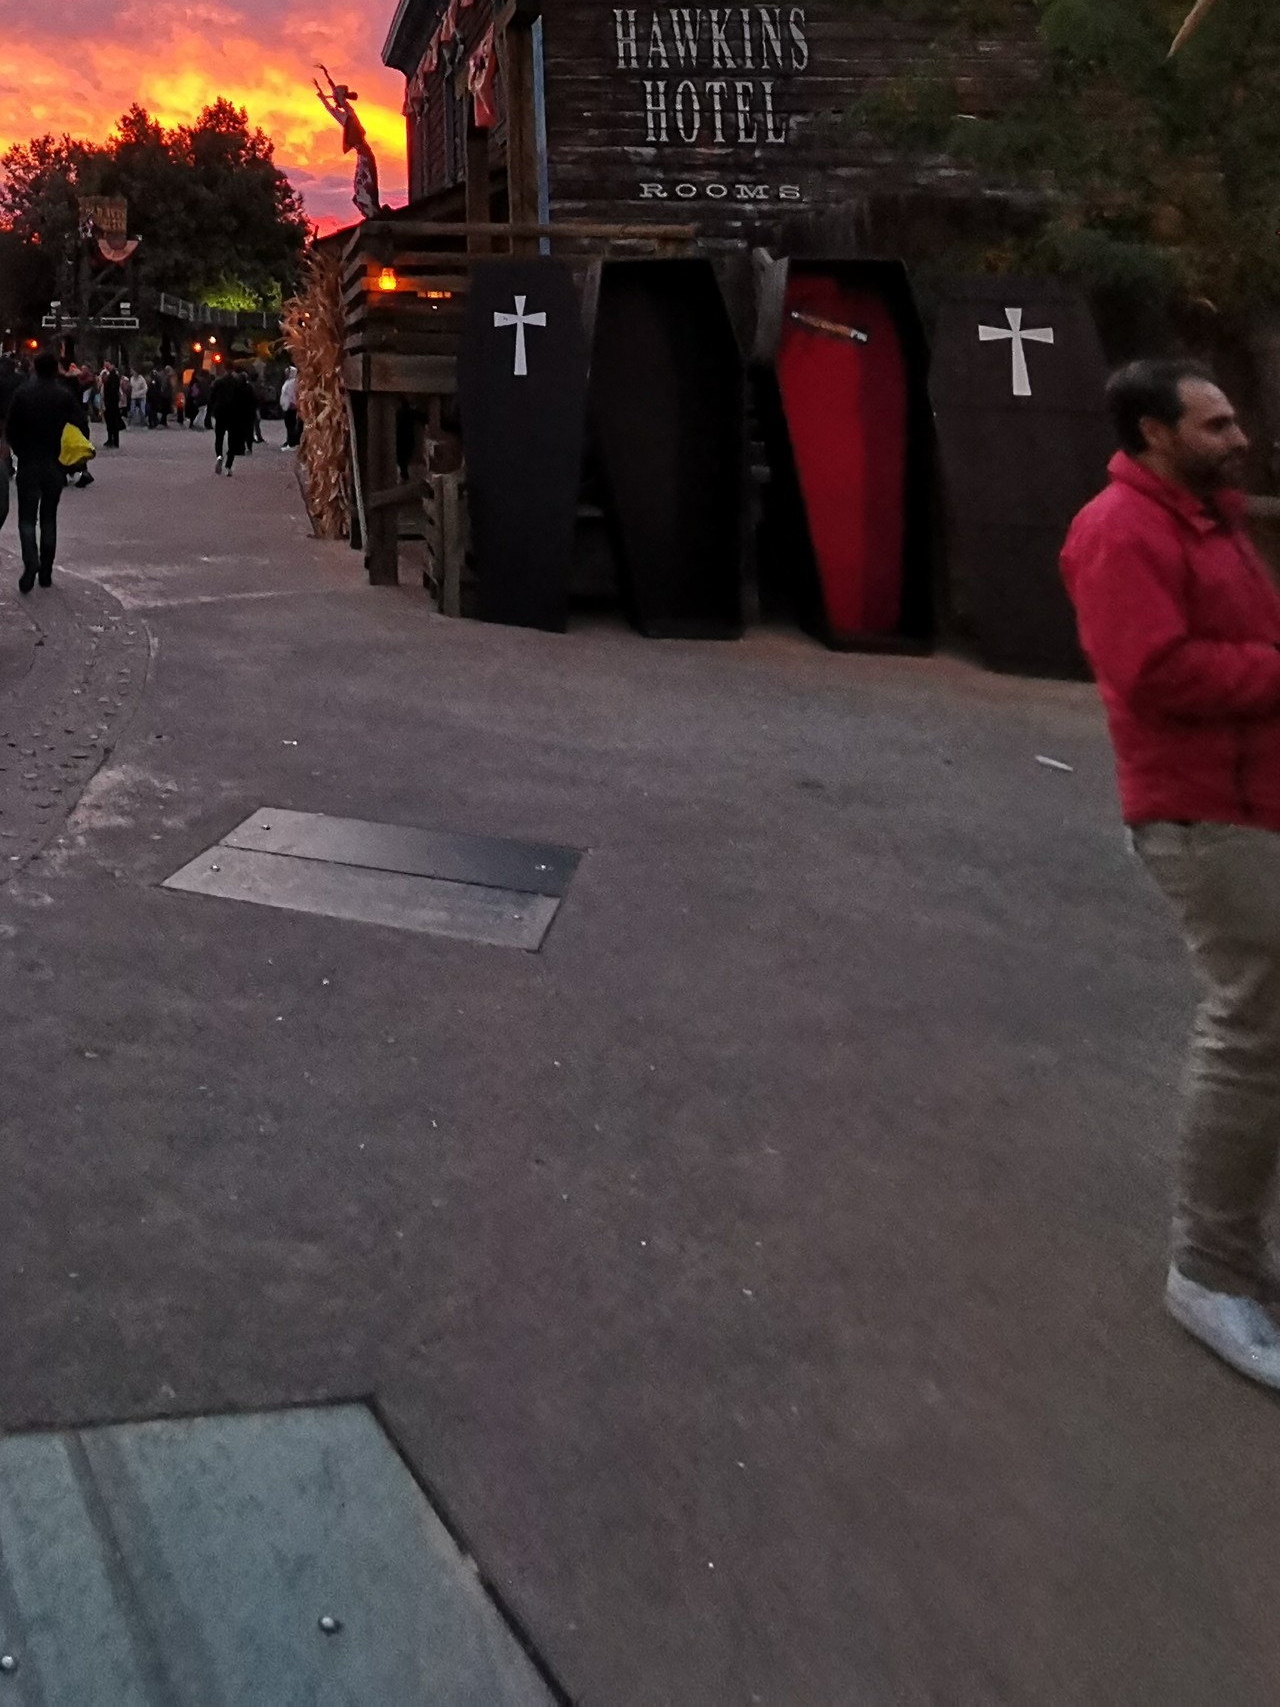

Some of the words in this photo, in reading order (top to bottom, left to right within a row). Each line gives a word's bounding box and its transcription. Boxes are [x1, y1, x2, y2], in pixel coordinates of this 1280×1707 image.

[613, 7, 809, 71] HAWKINS
[643, 80, 786, 143] HOTEL
[639, 183, 801, 199] ROOMS
